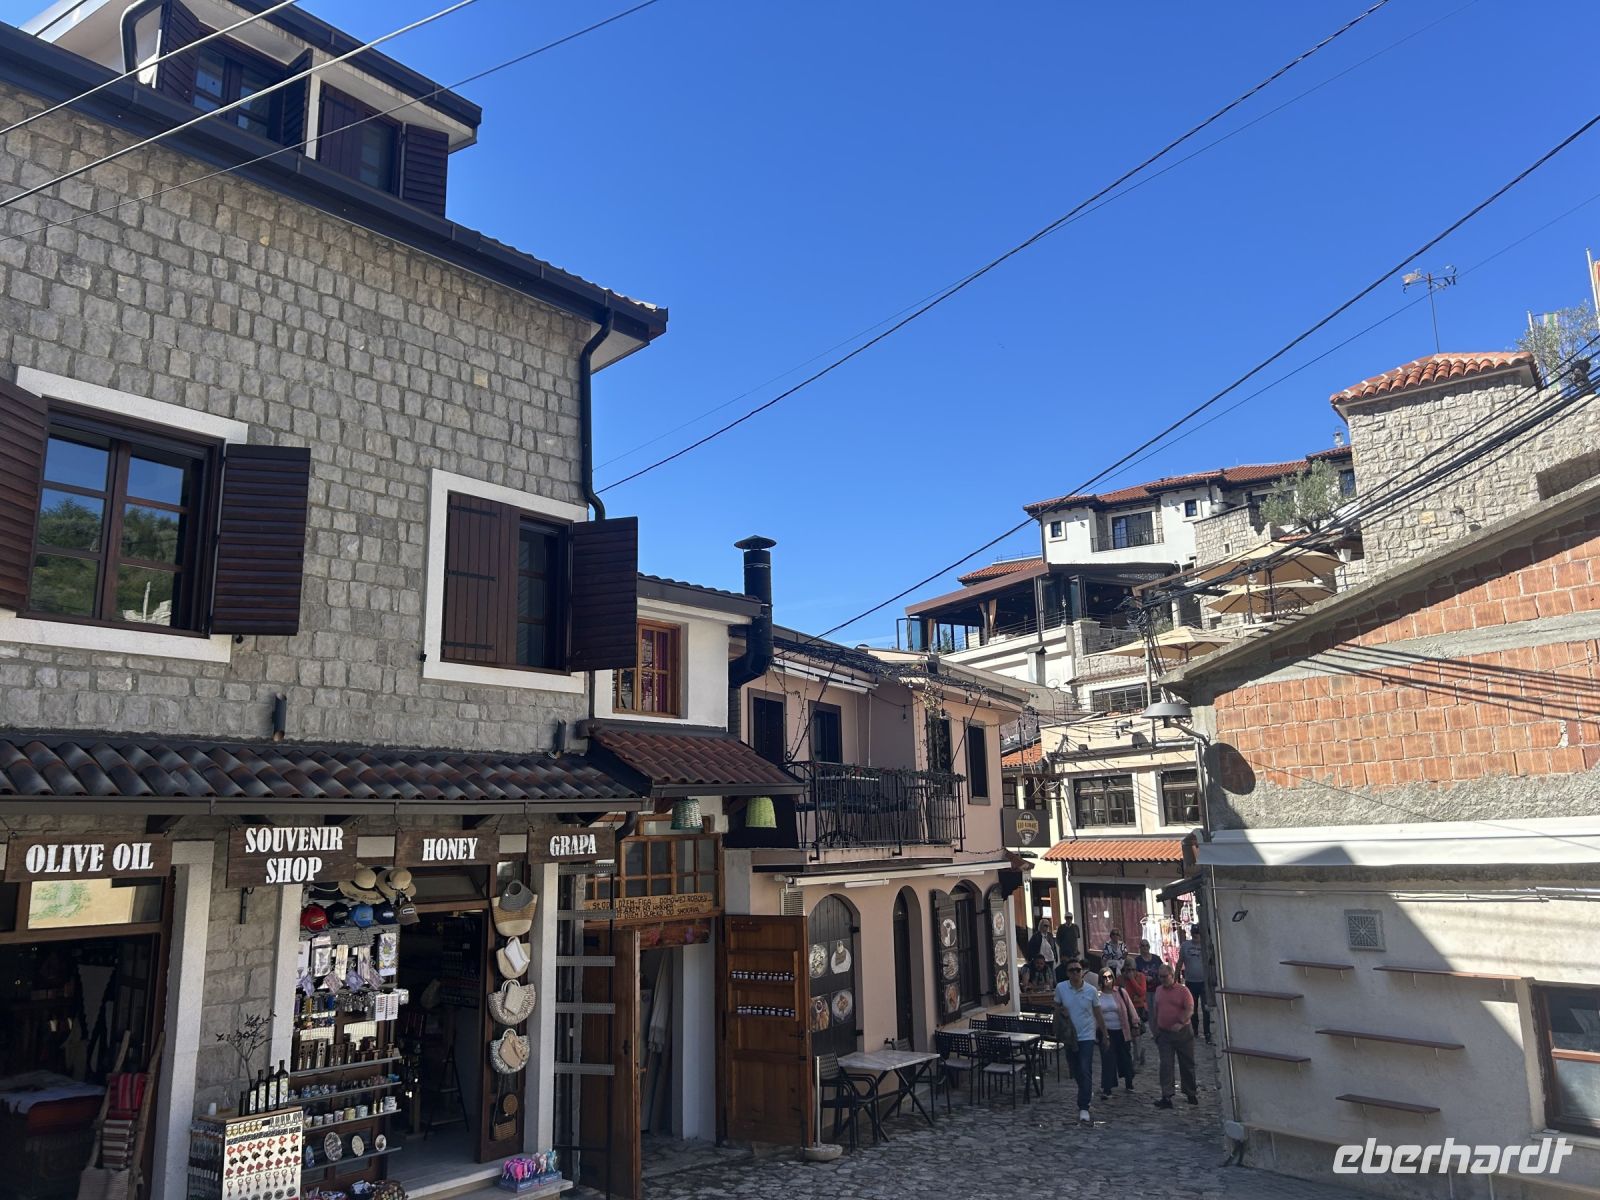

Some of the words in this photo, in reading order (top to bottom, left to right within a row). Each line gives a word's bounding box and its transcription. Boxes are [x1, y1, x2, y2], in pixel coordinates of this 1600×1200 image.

[245, 826, 344, 853] SOUVENIR
[422, 837, 478, 861] HONEY
[549, 834, 597, 857] GRAPA
[25, 843, 105, 873] OLIVE
[112, 843, 154, 871] OIL
[265, 856, 323, 884] SHOP
